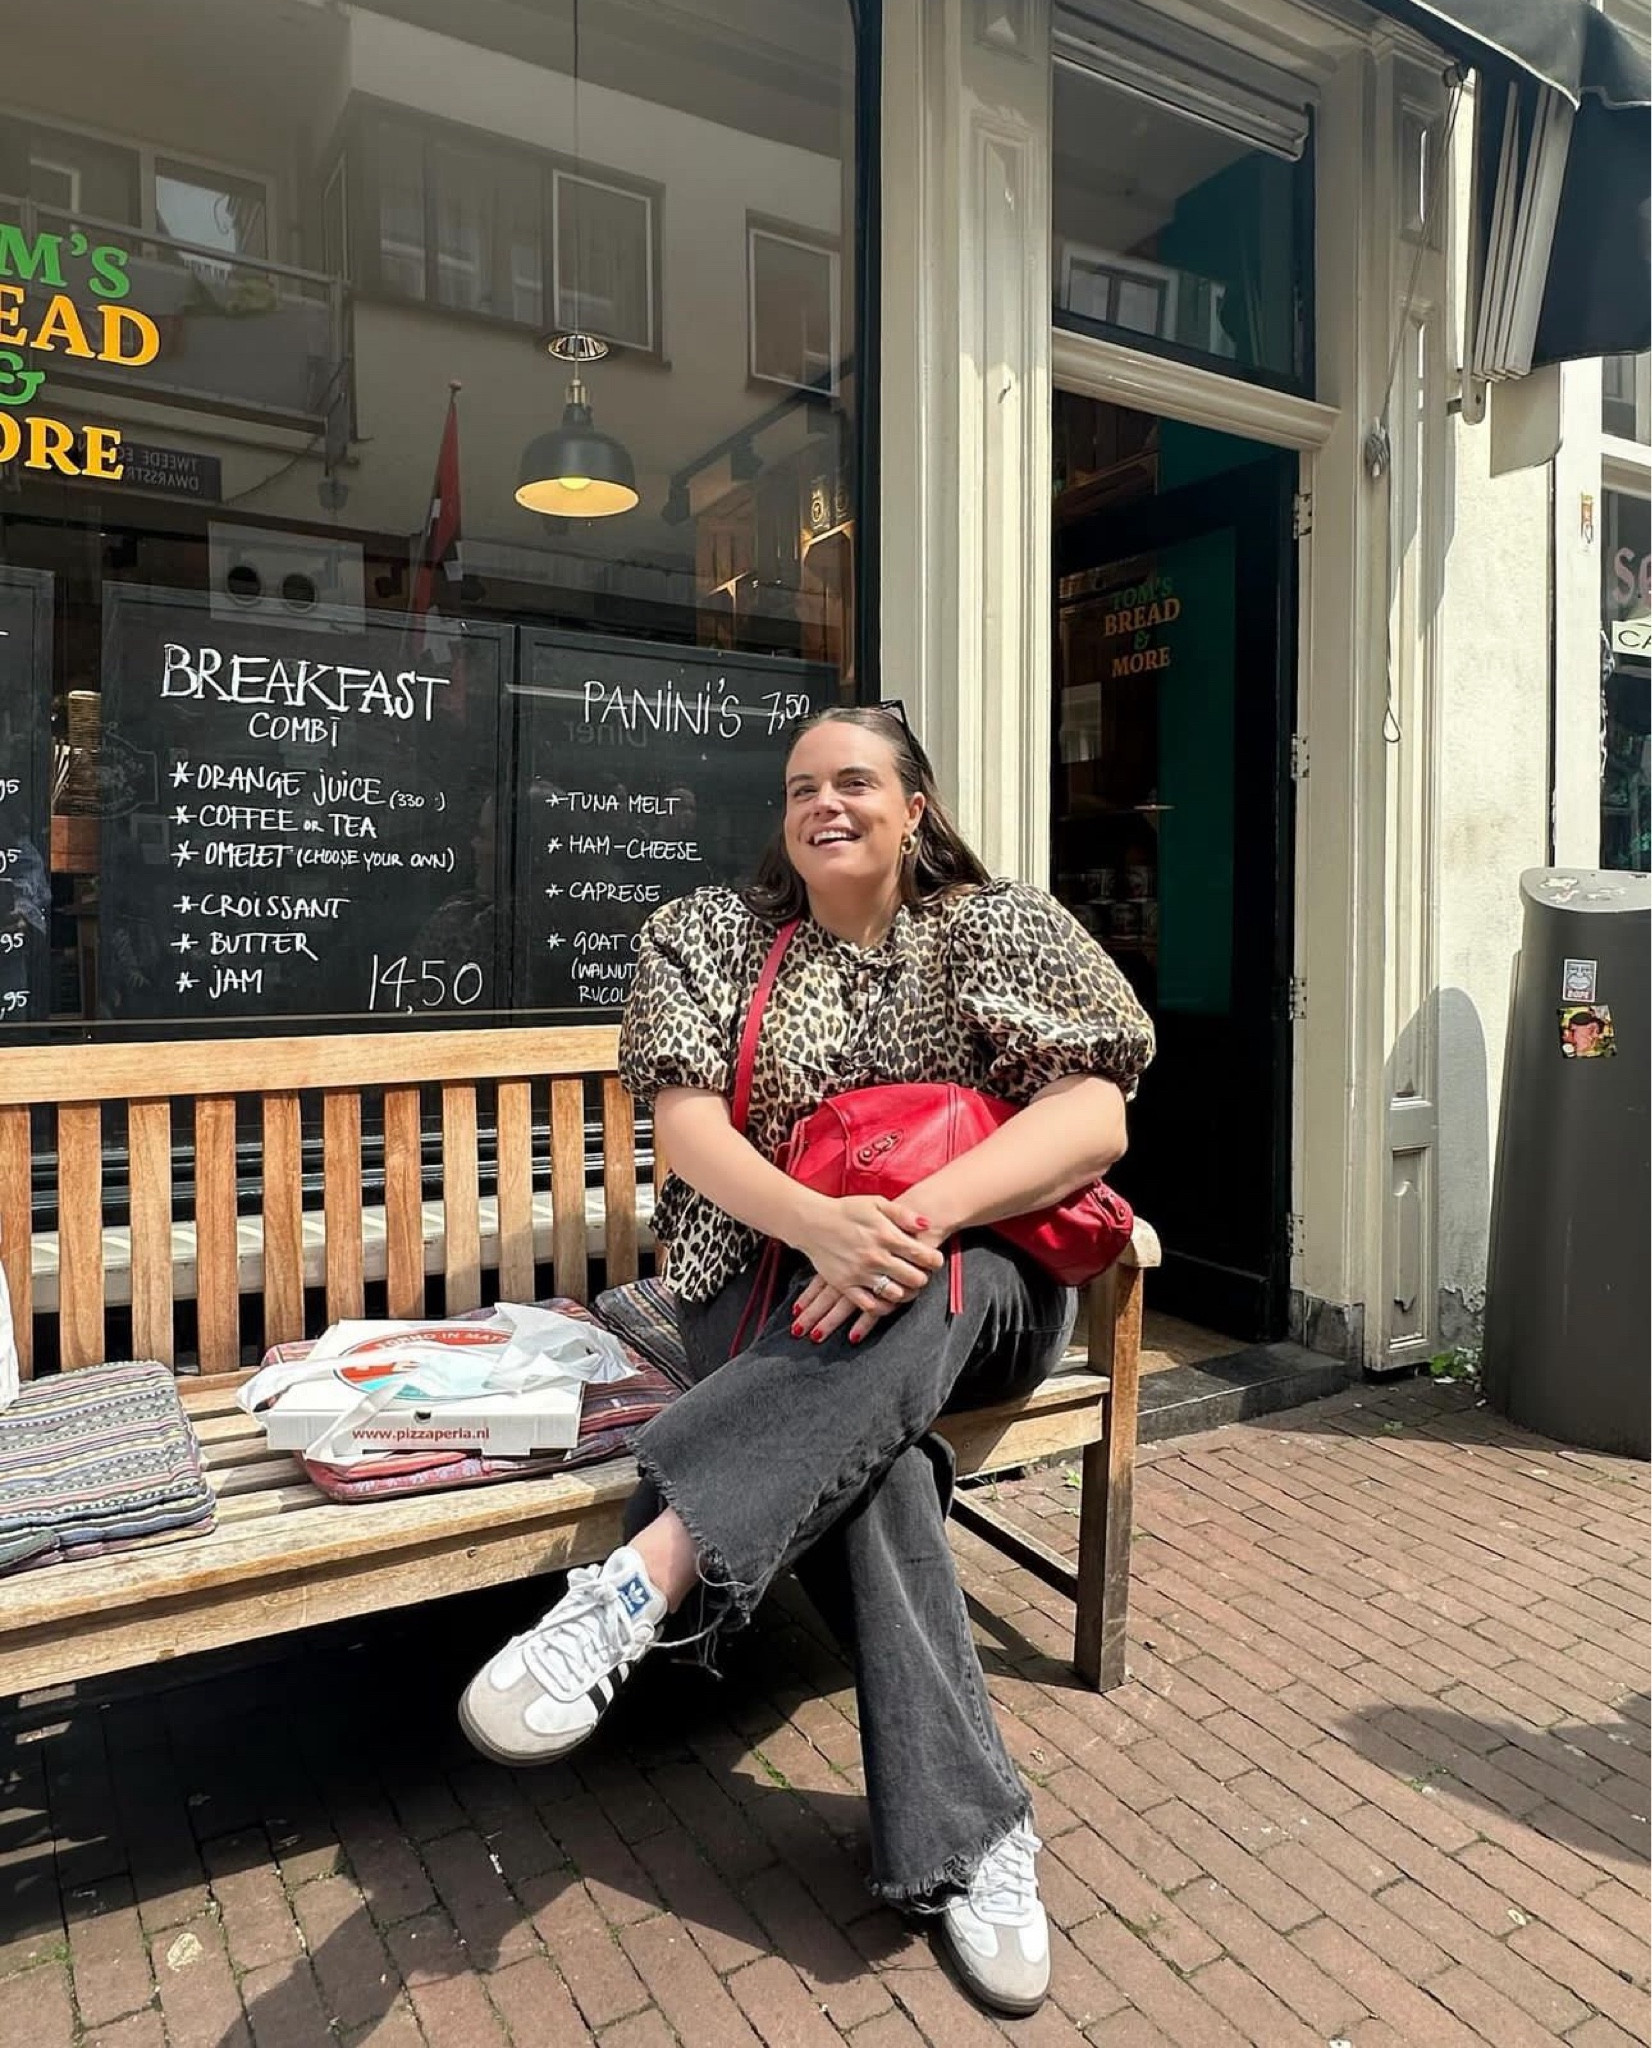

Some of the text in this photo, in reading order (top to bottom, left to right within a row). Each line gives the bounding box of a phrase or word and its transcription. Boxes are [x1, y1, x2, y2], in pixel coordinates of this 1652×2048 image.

[0, 284, 160, 366] EAD
[1104, 597, 1182, 636] BREAD
[1111, 646, 1171, 678] MORE
[160, 643, 451, 722] BREAKFAST
[760, 691, 810, 735] 7,50
[197, 764, 307, 799] ORANGE
[567, 791, 681, 816] TUNA MELT
[199, 804, 299, 832] COFFEE
[328, 813, 378, 839] TEA
[204, 842, 295, 869] OMELET
[296, 848, 361, 870] (CHOOSE
[363, 851, 404, 873] YOUR
[569, 834, 703, 861] HAM-CHEESE
[569, 881, 662, 903] CAPRESE
[209, 931, 319, 961] BUTTER
[573, 930, 627, 956] GOAT
[209, 954, 484, 1015] JAM 14,50
[352, 1427, 489, 1441] www.pizzaperla.nl
